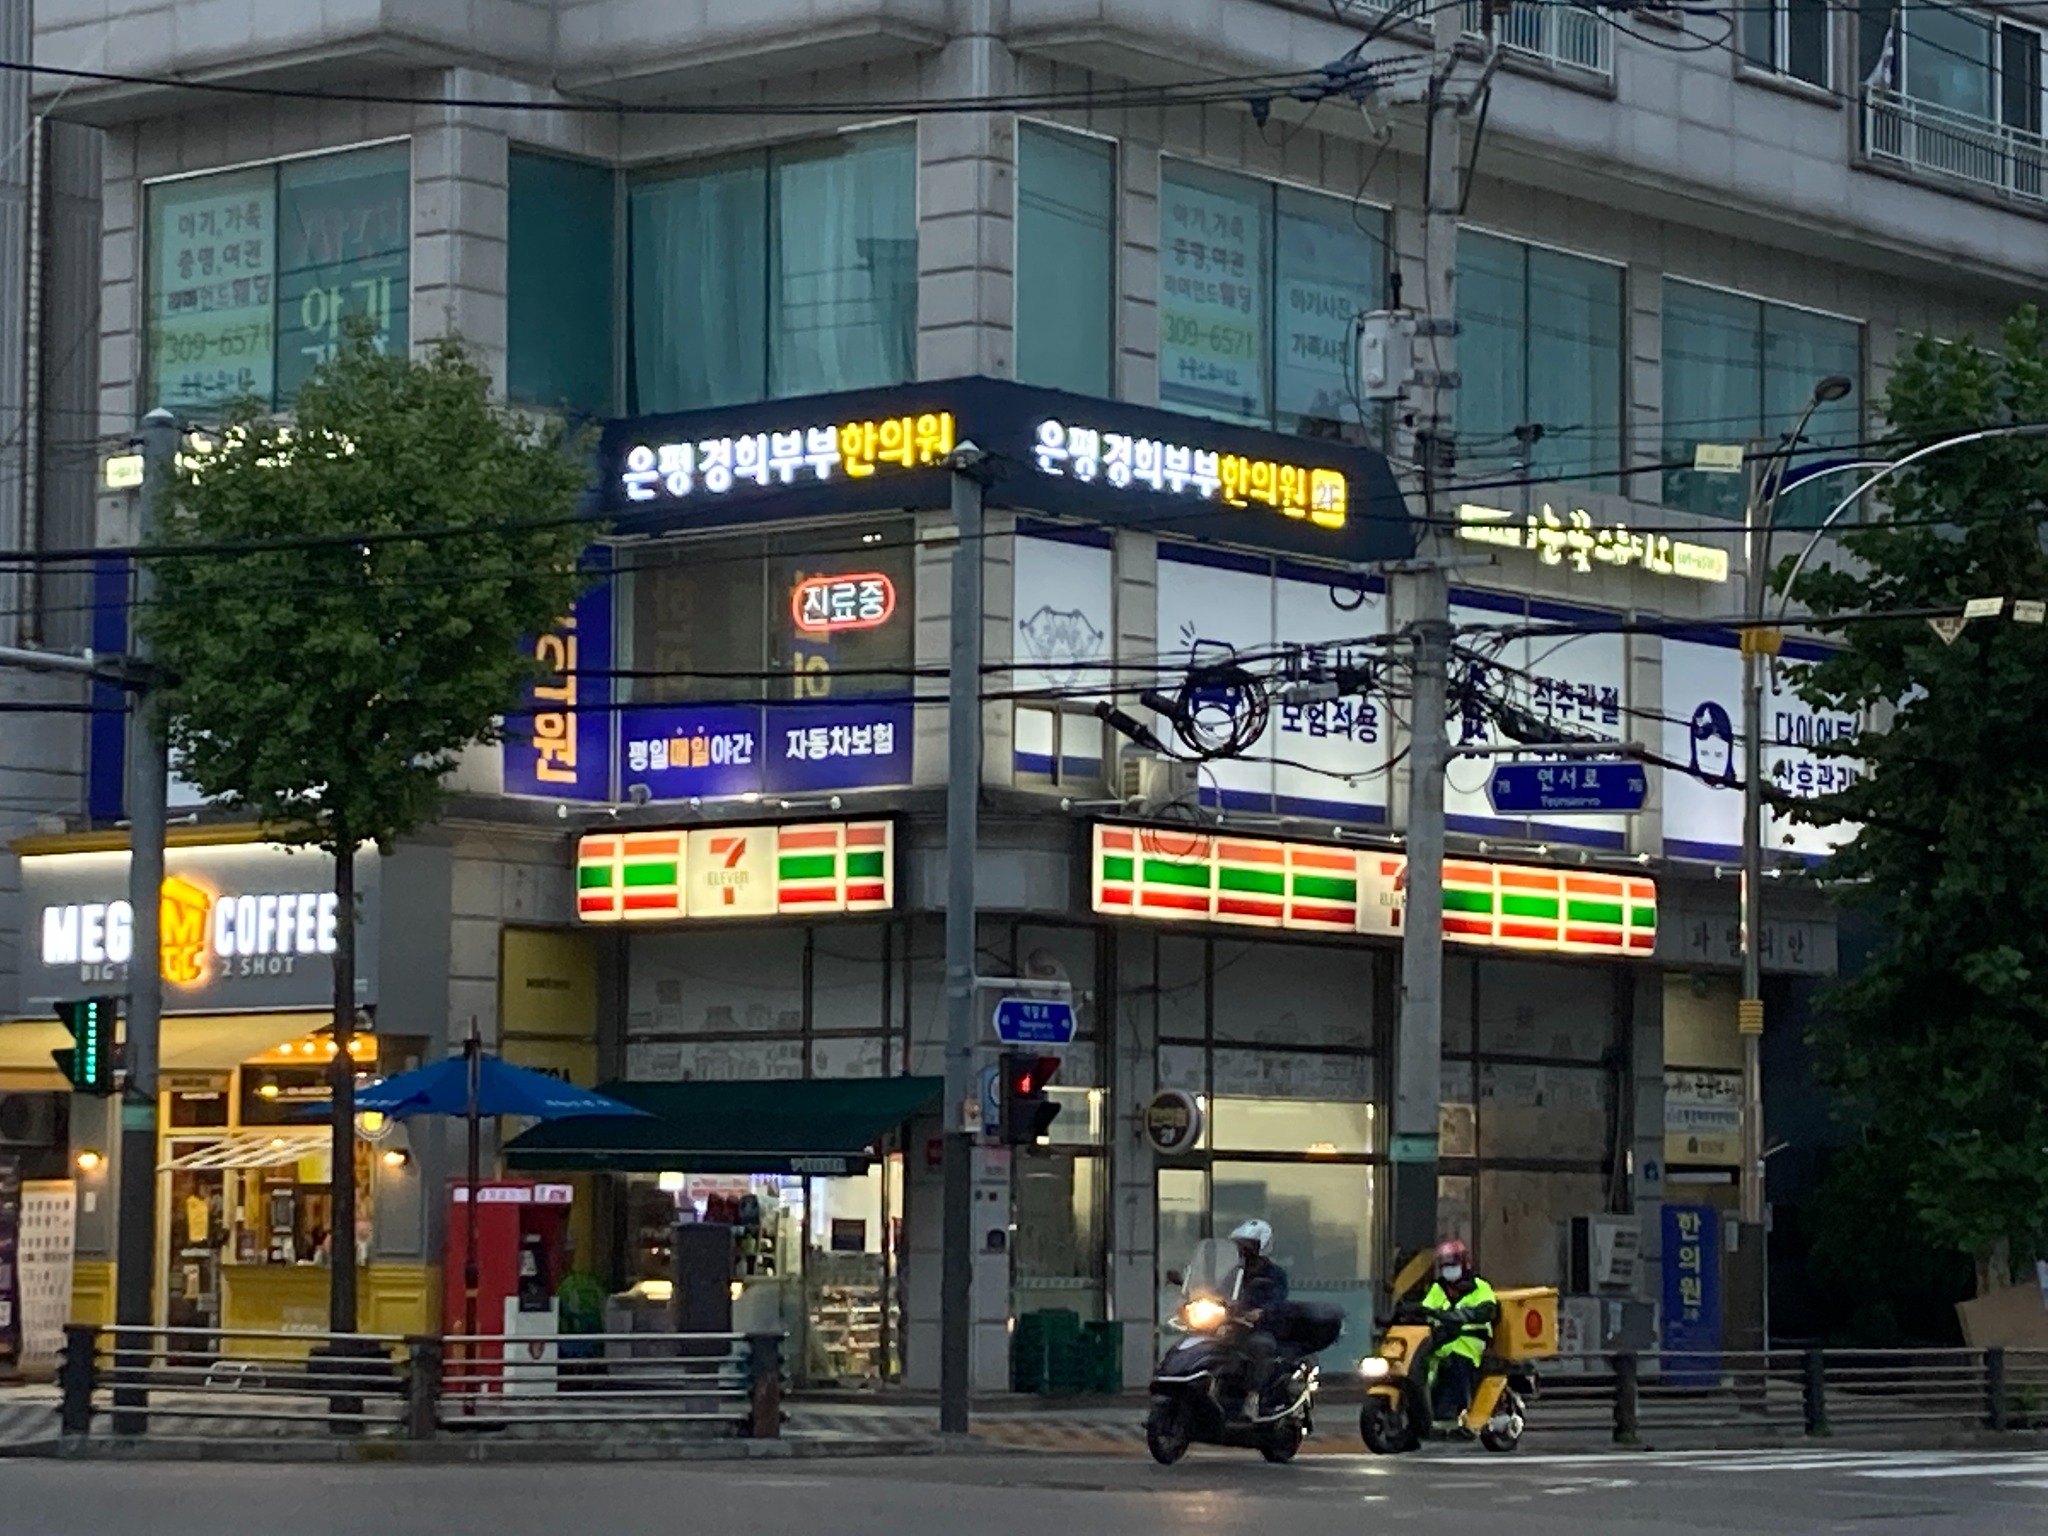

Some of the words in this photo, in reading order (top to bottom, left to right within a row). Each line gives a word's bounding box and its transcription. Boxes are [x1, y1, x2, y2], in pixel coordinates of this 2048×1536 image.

[301, 276, 391, 340] 아기
[163, 323, 271, 365] 309-6571
[1163, 314, 1253, 359] 309-6571
[622, 446, 692, 501] 은평
[1034, 420, 1099, 483] 은평
[802, 580, 885, 625] 진료중
[786, 722, 895, 761] 자동차보험
[1537, 767, 1601, 792] 연서로
[42, 901, 133, 964] MEG
[214, 892, 339, 956] COFFEE
[80, 964, 113, 982] BIG
[221, 961, 233, 978] 2
[240, 955, 295, 977] SHOT
[1676, 1211, 1702, 1307] 한의원
